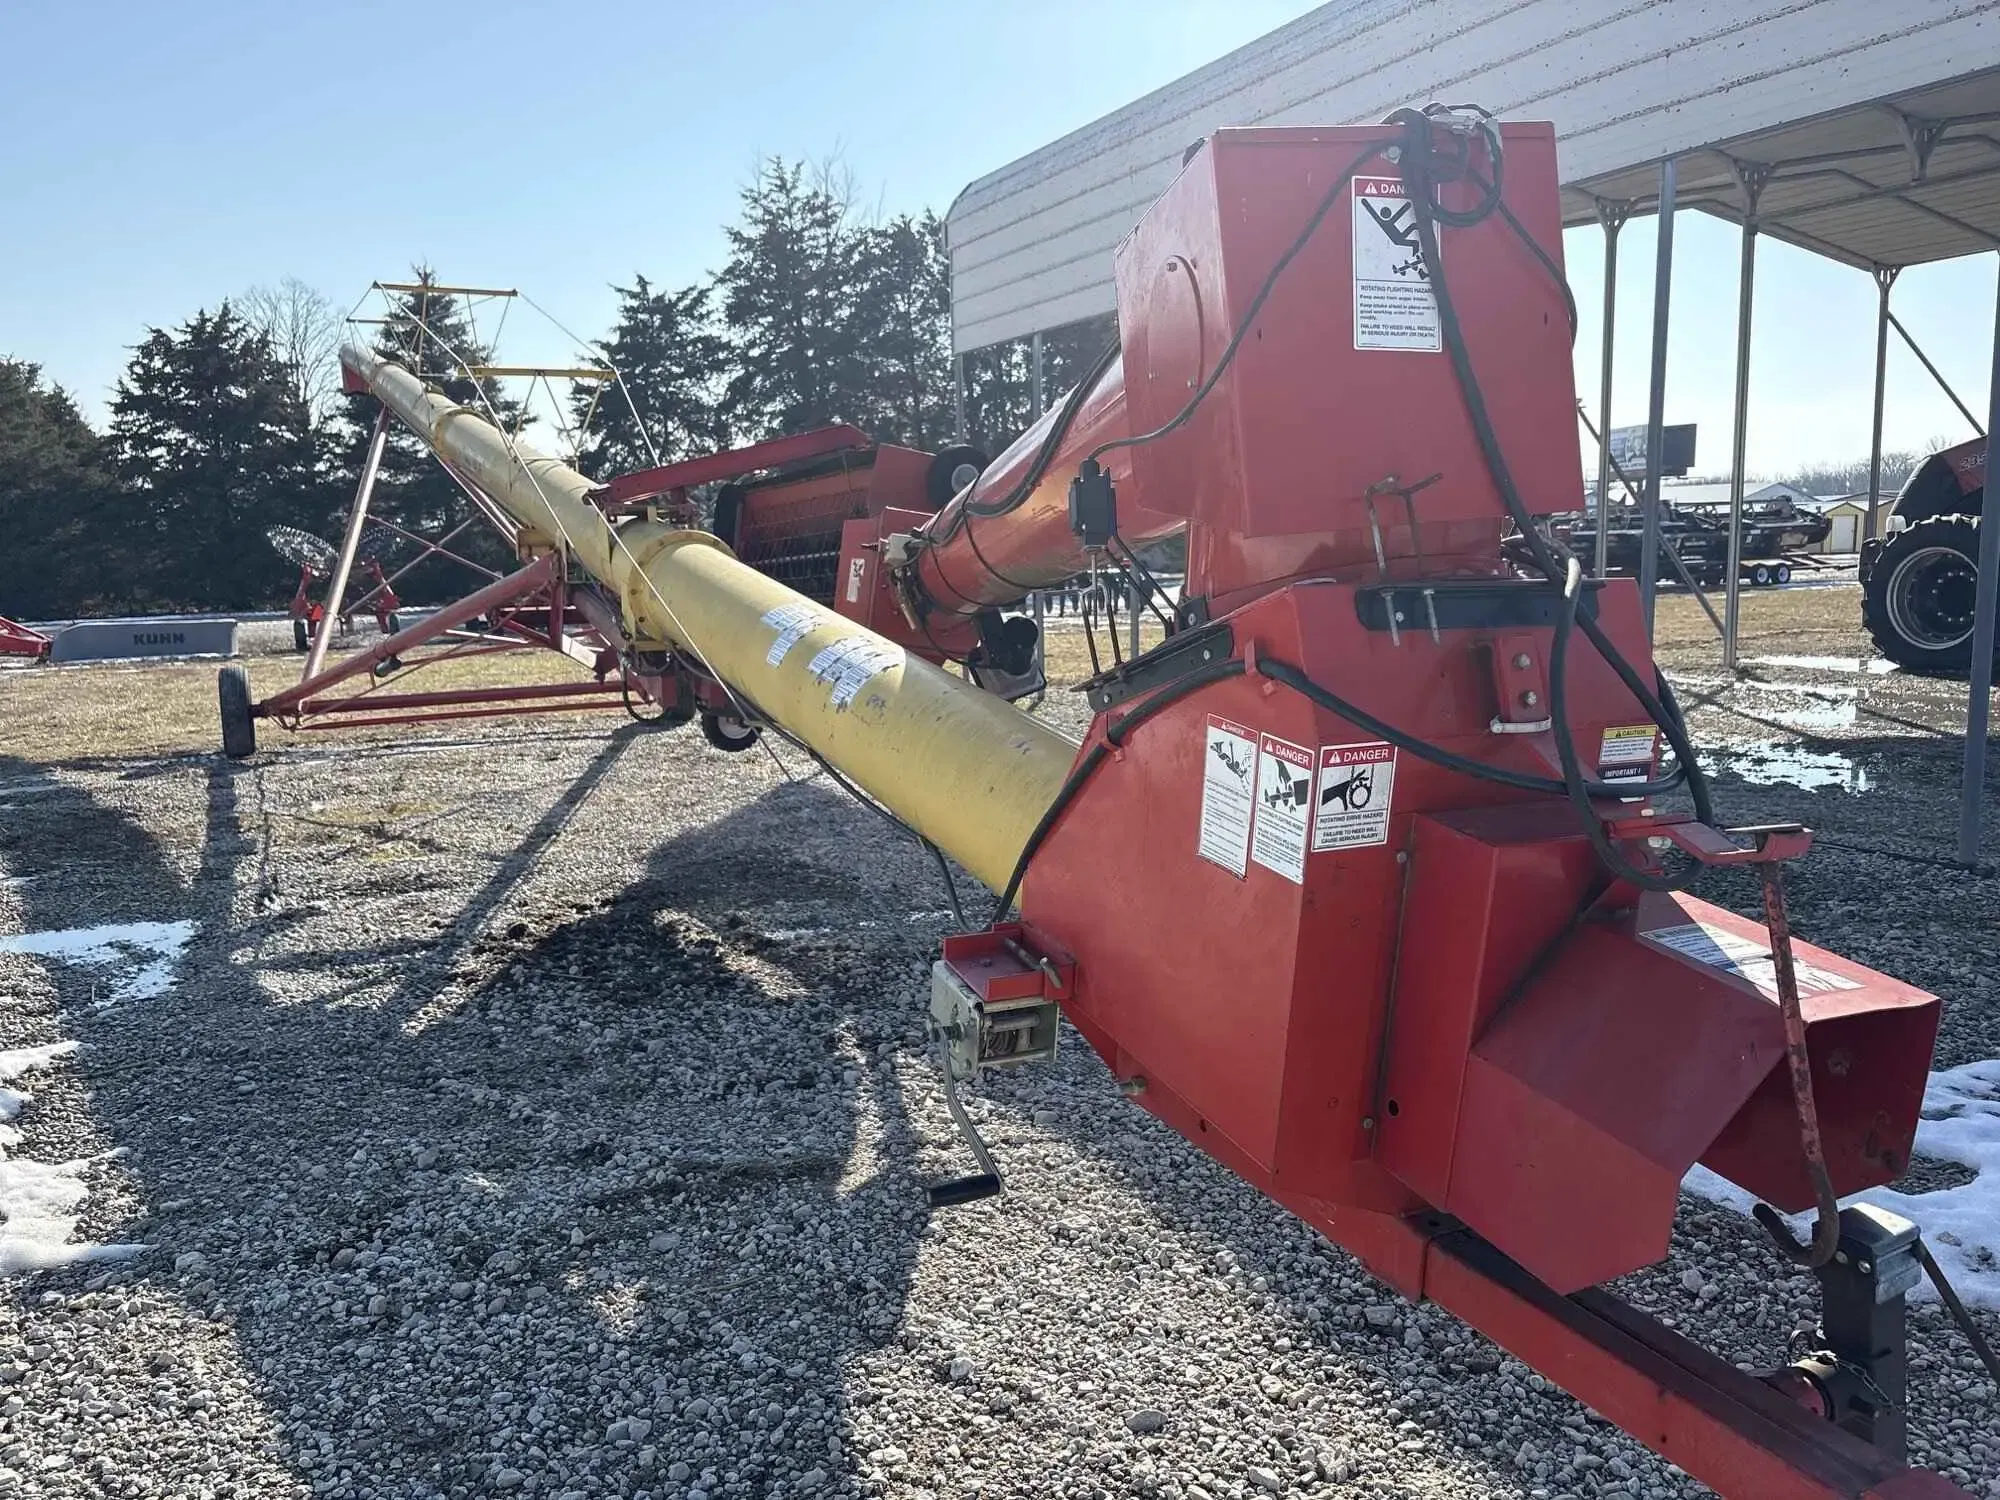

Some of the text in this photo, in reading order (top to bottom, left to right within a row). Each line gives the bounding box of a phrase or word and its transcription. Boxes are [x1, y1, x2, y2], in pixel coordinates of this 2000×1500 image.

[133, 632, 186, 645] KUHN
[1275, 744, 1309, 767] DANGER
[1343, 748, 1389, 762] DANGER
